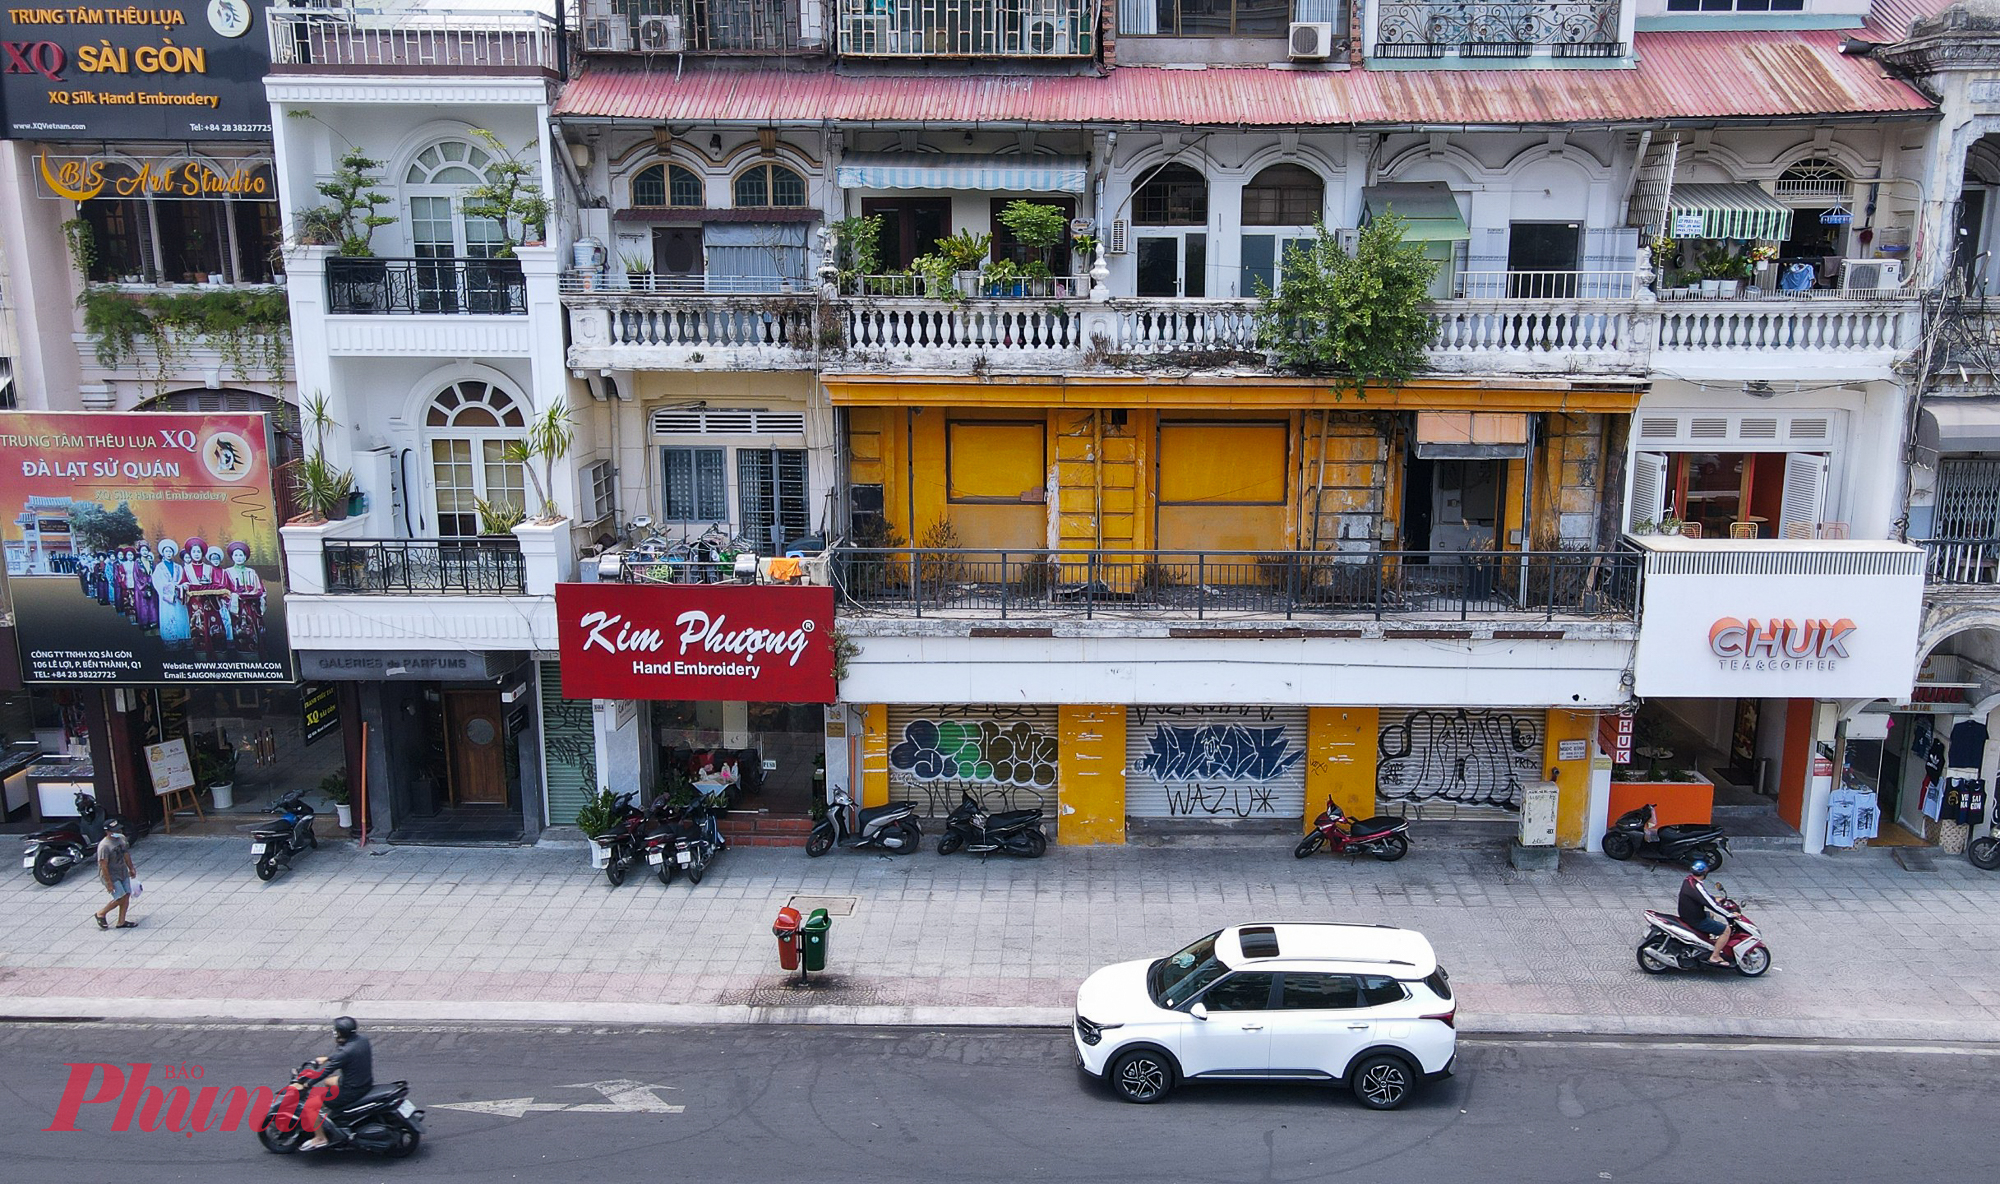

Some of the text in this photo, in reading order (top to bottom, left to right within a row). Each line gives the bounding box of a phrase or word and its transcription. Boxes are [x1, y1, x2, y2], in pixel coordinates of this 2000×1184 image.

[8, 6, 185, 30] TRUNG TÂM THÊU LỤA
[1, 38, 206, 81] XQ SÀI GÒN
[48, 91, 220, 108] XQ Silk Hand Embroidery
[13, 122, 86, 131] www.XQVietnam.com
[222, 124, 232, 132] 28
[232, 124, 272, 132] 38227725
[116, 163, 176, 196] Art
[182, 162, 267, 197] Studio
[0, 429, 197, 452] TRUNG TÂM THÊU LỤA XQ
[22, 457, 180, 481] ĐÀ LẠT SỬ QUÁN
[95, 490, 228, 503] XQ Silk Hand Embroidery
[580, 609, 809, 667] Kim Phượng
[1708, 616, 1857, 659] CHUK
[31, 650, 133, 659] CÔNG TY TNHH XQ SÀI GÒN
[48, 660, 58, 668] LÊ
[162, 662, 282, 670] Website: WWW.XQVIETNAM.COM
[319, 658, 383, 669] GALERIES
[403, 658, 467, 668] PARFUMS
[632, 660, 761, 679] Hand Embroidery
[34, 671, 50, 679] TEL:
[78, 671, 117, 679] 38227725
[187, 671, 284, 680] SAIGON@XQVIETNAM.COM
[306, 710, 320, 727] XQ
